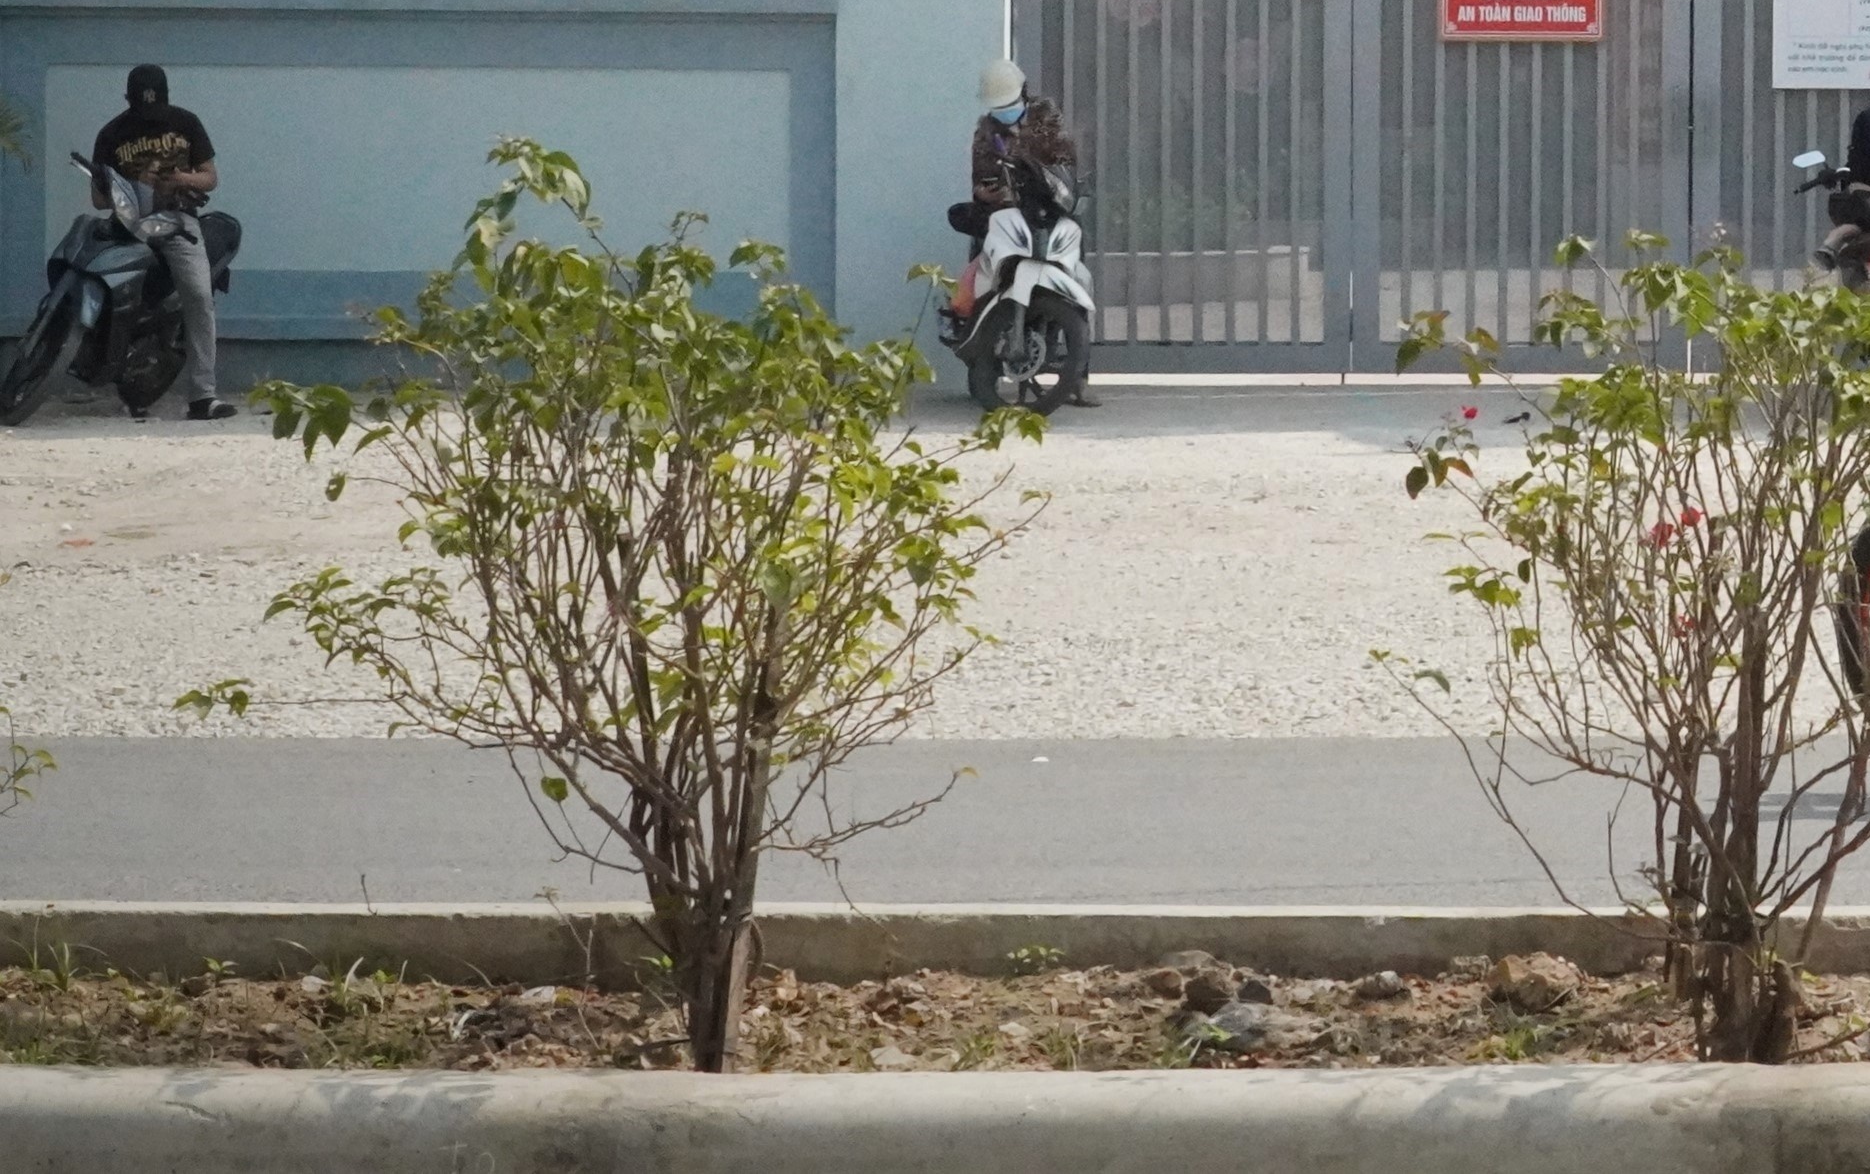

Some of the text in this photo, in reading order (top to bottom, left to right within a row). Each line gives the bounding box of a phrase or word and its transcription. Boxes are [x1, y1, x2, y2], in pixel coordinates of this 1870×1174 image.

[1457, 2, 1587, 23] AN TOÀN GIAO THÔNG
